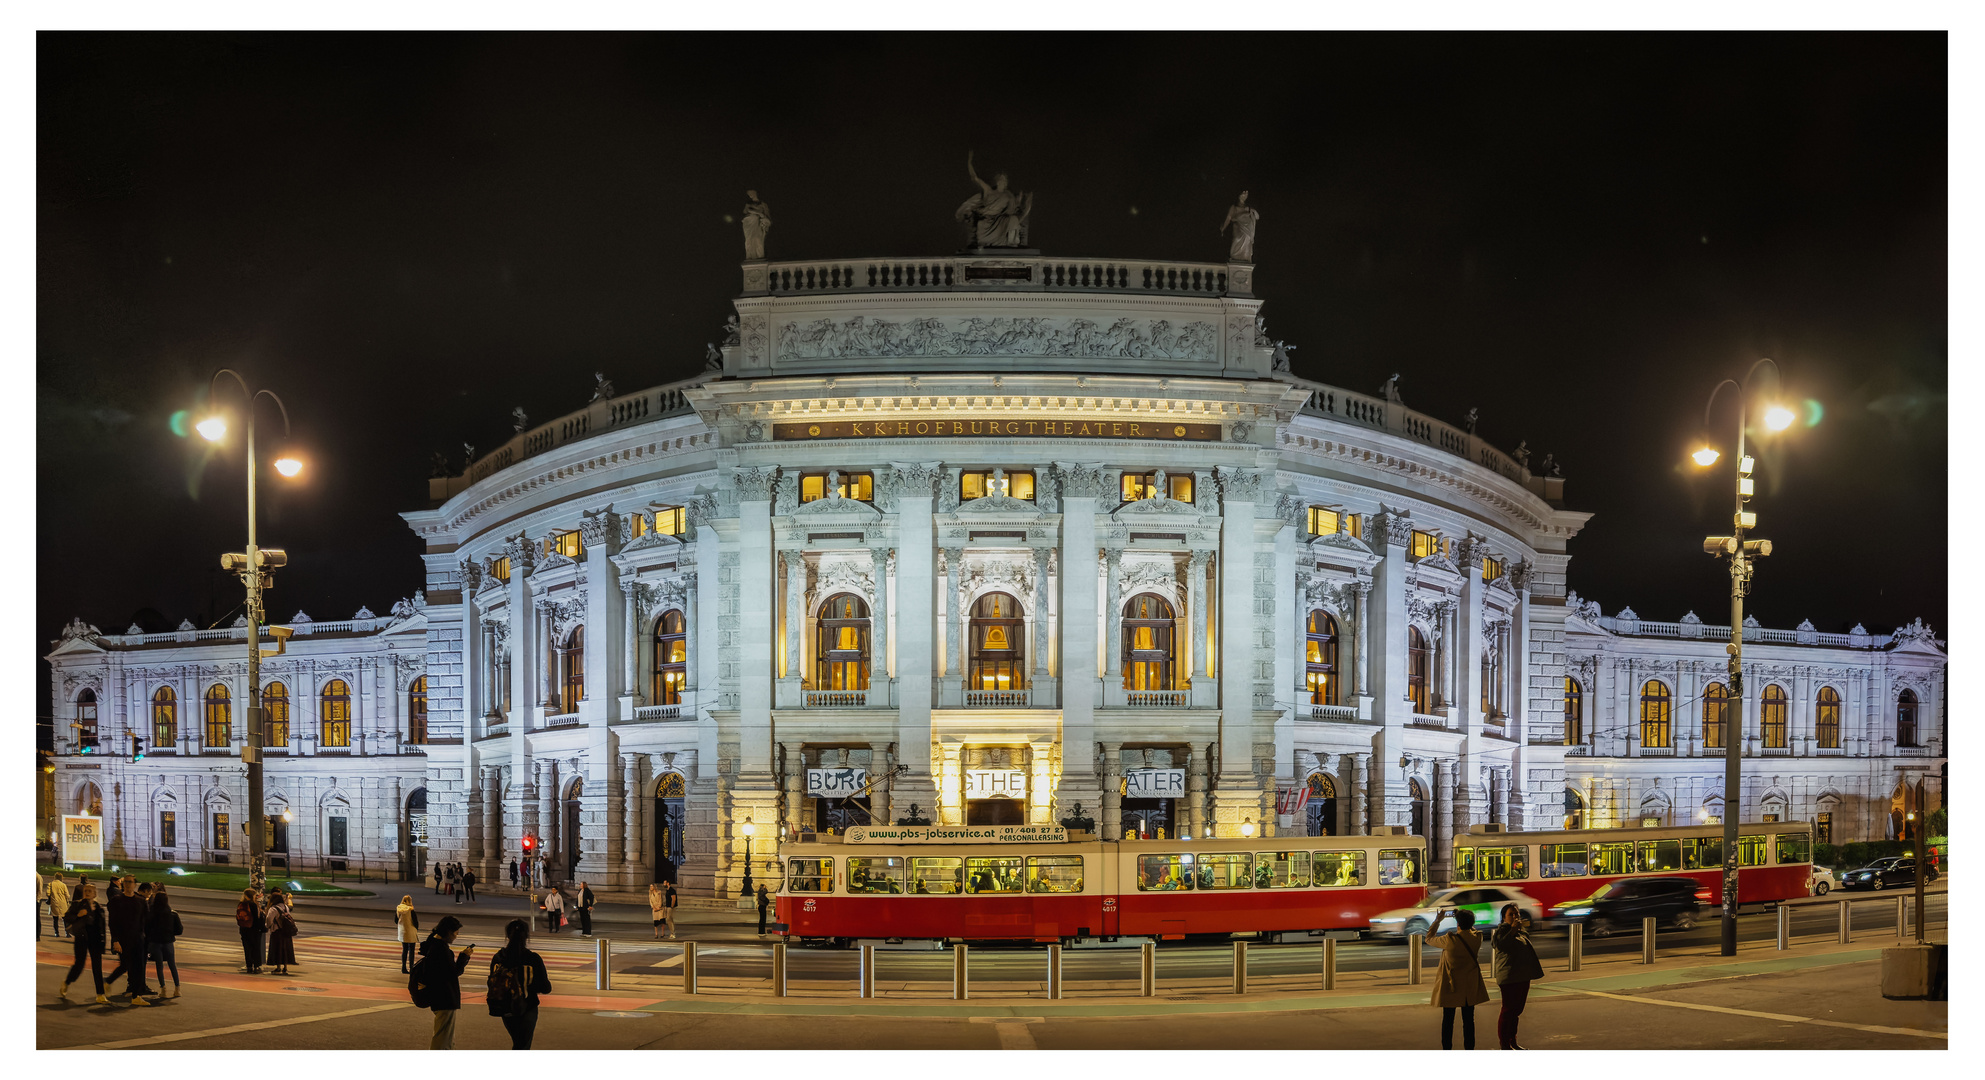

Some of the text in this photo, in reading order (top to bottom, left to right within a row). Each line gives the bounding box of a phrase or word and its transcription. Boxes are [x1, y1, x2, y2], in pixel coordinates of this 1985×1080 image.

[1127, 772, 1182, 790] ATER
[73, 824, 92, 833] NOS
[66, 833, 98, 843] FERATU
[869, 828, 996, 841] www.pbs-jobservice.at
[999, 834, 1065, 842] PERSONALLEASING
